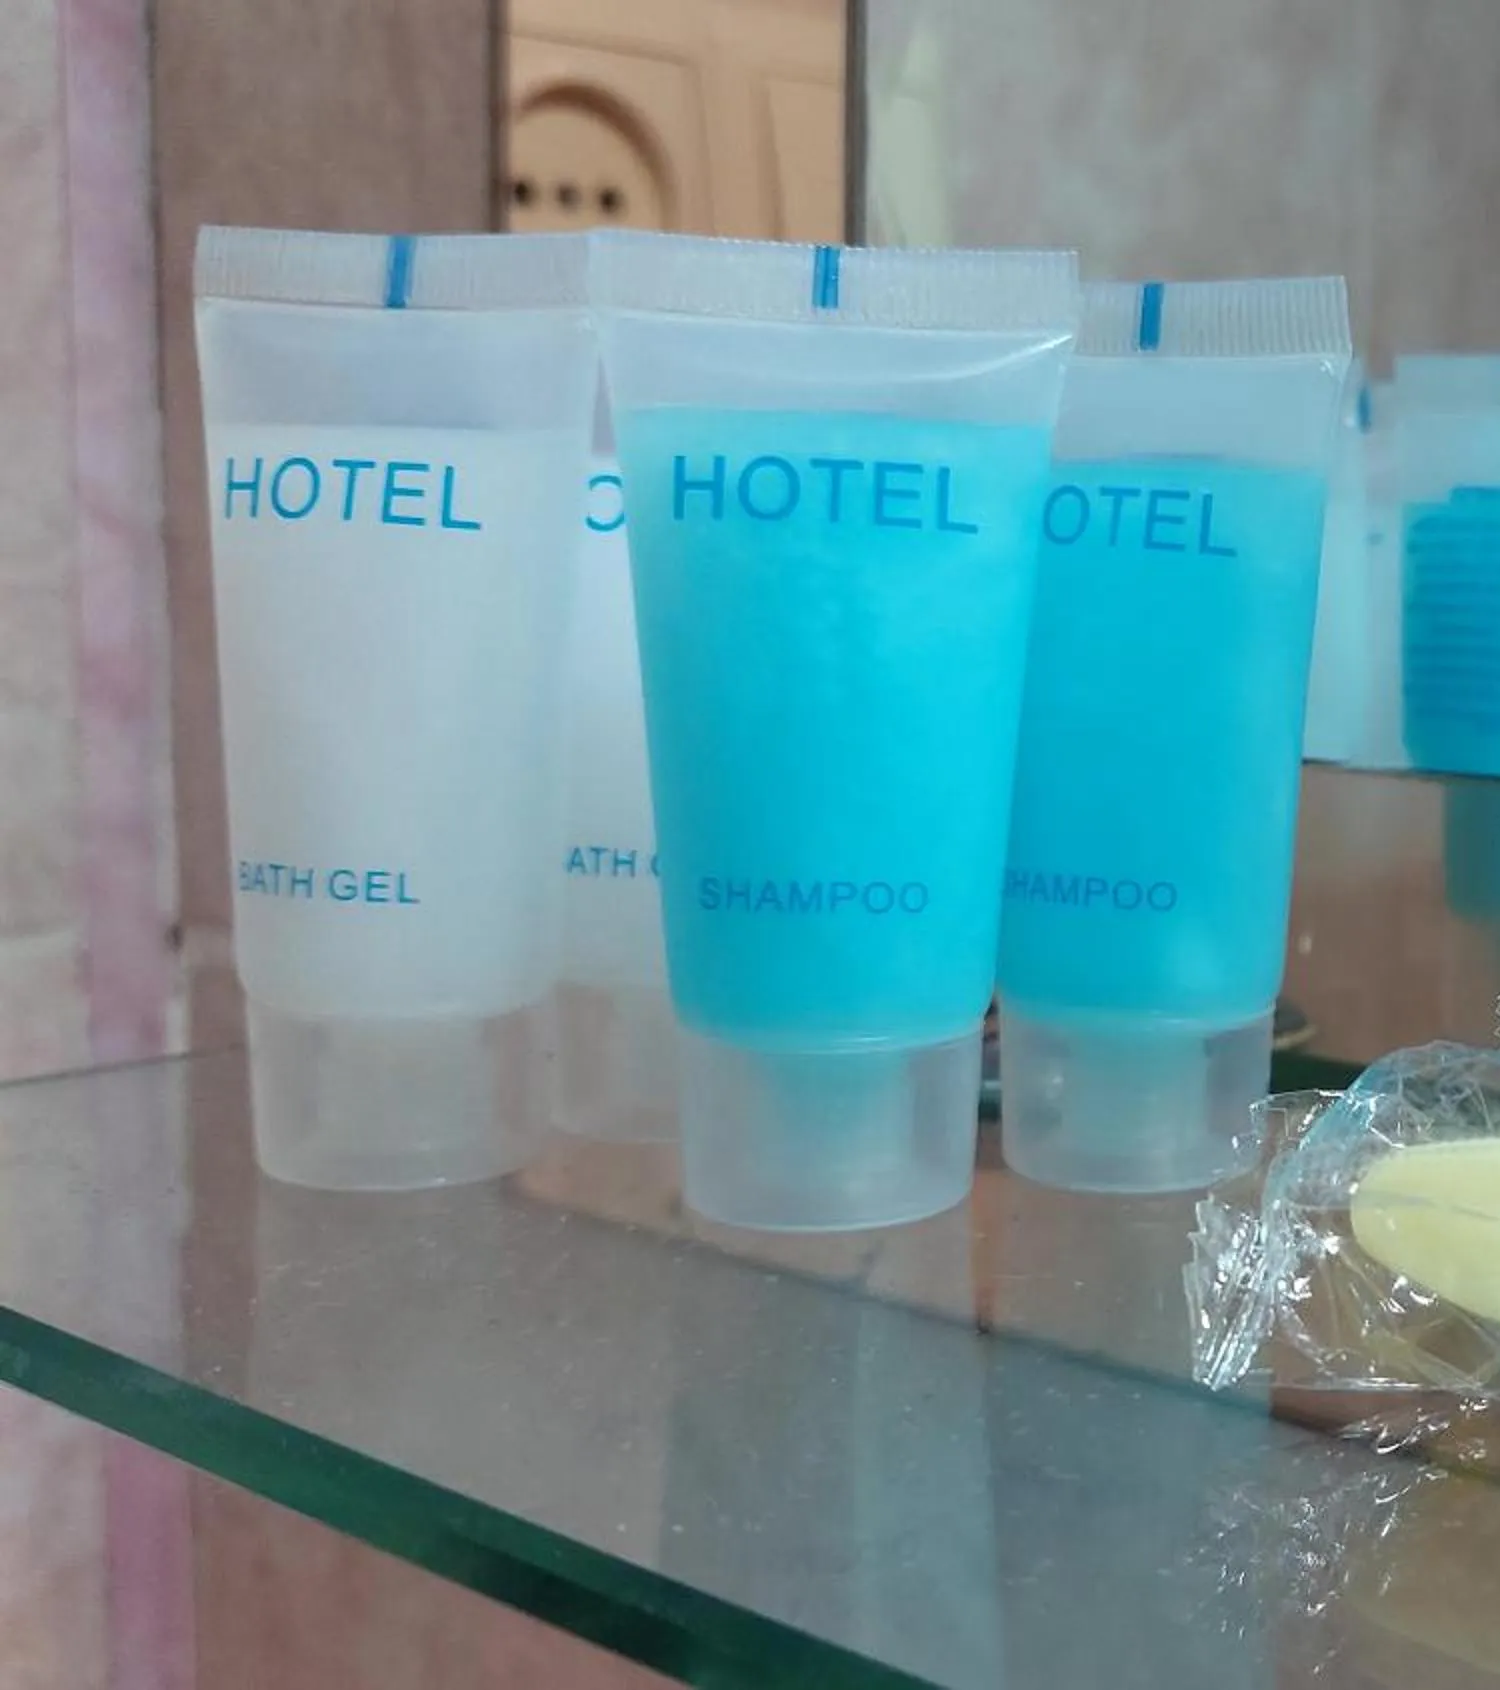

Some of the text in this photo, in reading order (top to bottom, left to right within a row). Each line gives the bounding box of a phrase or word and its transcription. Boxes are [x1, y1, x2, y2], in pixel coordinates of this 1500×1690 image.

[225, 456, 482, 531] HOTEL
[673, 455, 979, 535] HOTEL
[1043, 484, 1238, 558] OTEL
[239, 861, 420, 904] BATH GEL
[565, 846, 638, 878] ATH
[699, 876, 930, 916] SHAMPOO
